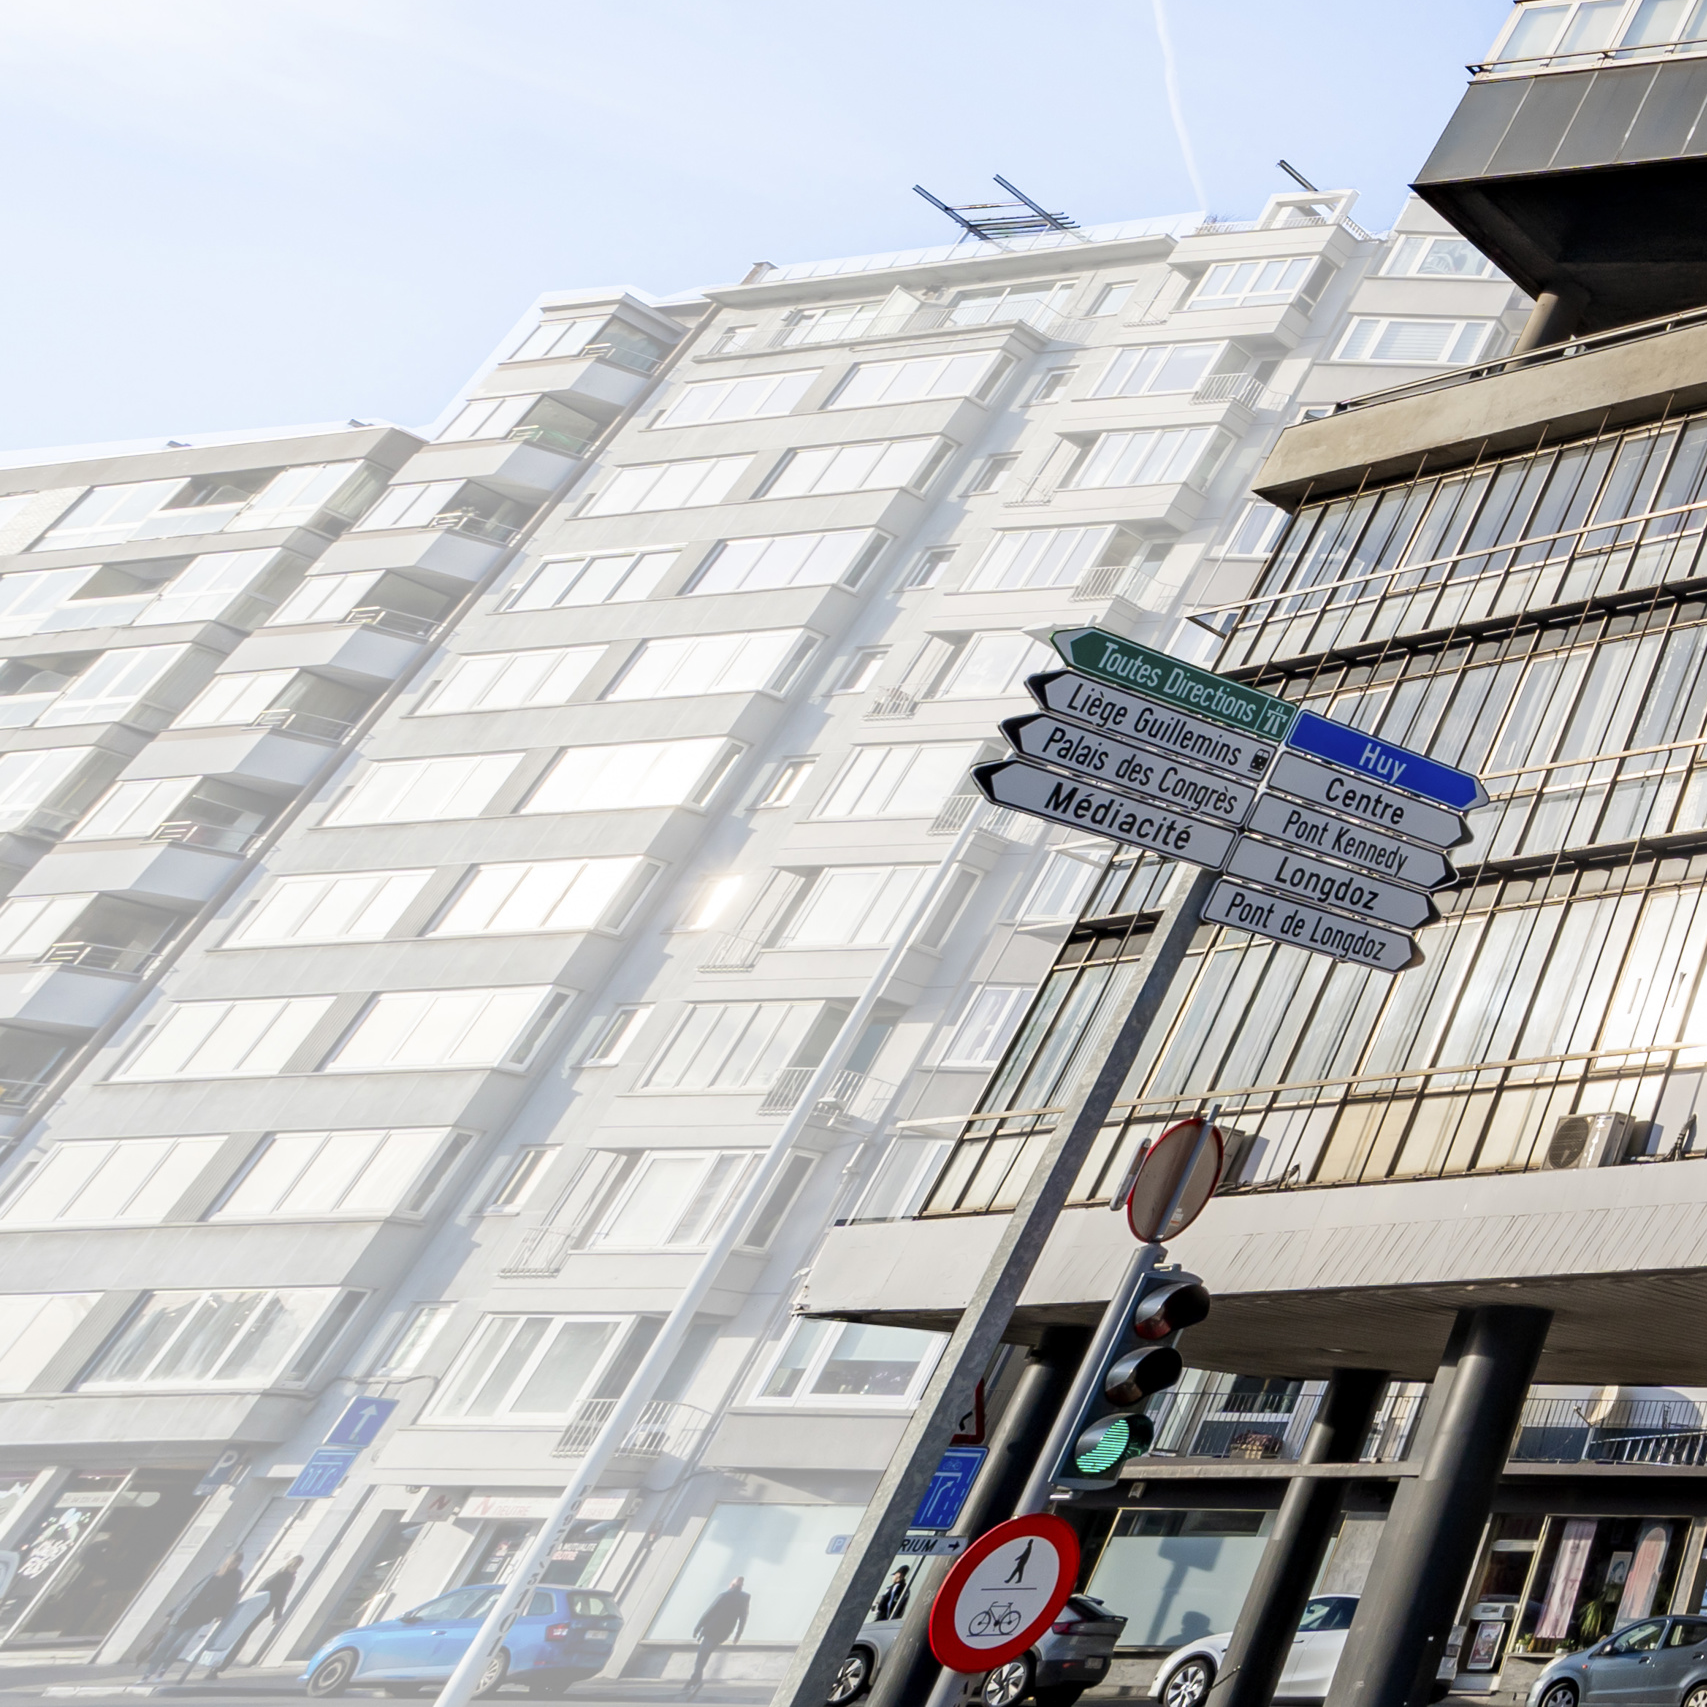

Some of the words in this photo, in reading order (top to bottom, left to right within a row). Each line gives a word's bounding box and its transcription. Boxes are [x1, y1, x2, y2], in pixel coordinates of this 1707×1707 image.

[1098, 641, 1162, 687] Toutes
[1163, 667, 1256, 723] Directions
[1067, 683, 1128, 728] Liège
[1134, 707, 1242, 766] Guillemins
[1042, 726, 1109, 771] Palais
[1115, 753, 1151, 786] des
[1158, 766, 1238, 815] Congrès
[1358, 743, 1407, 785] Huy
[1044, 781, 1194, 850] Médiacité
[1325, 777, 1404, 825] Centre
[1282, 809, 1329, 846] Pont
[1331, 826, 1409, 878] Kennedy
[1274, 856, 1379, 911] Longdoz
[1224, 892, 1275, 928] Pont
[1280, 909, 1306, 937] de
[1309, 916, 1387, 961] Longdoz
[209, 1450, 239, 1478] P
[552, 1550, 579, 1561] EUTRE
[900, 1539, 939, 1553] RIUM
